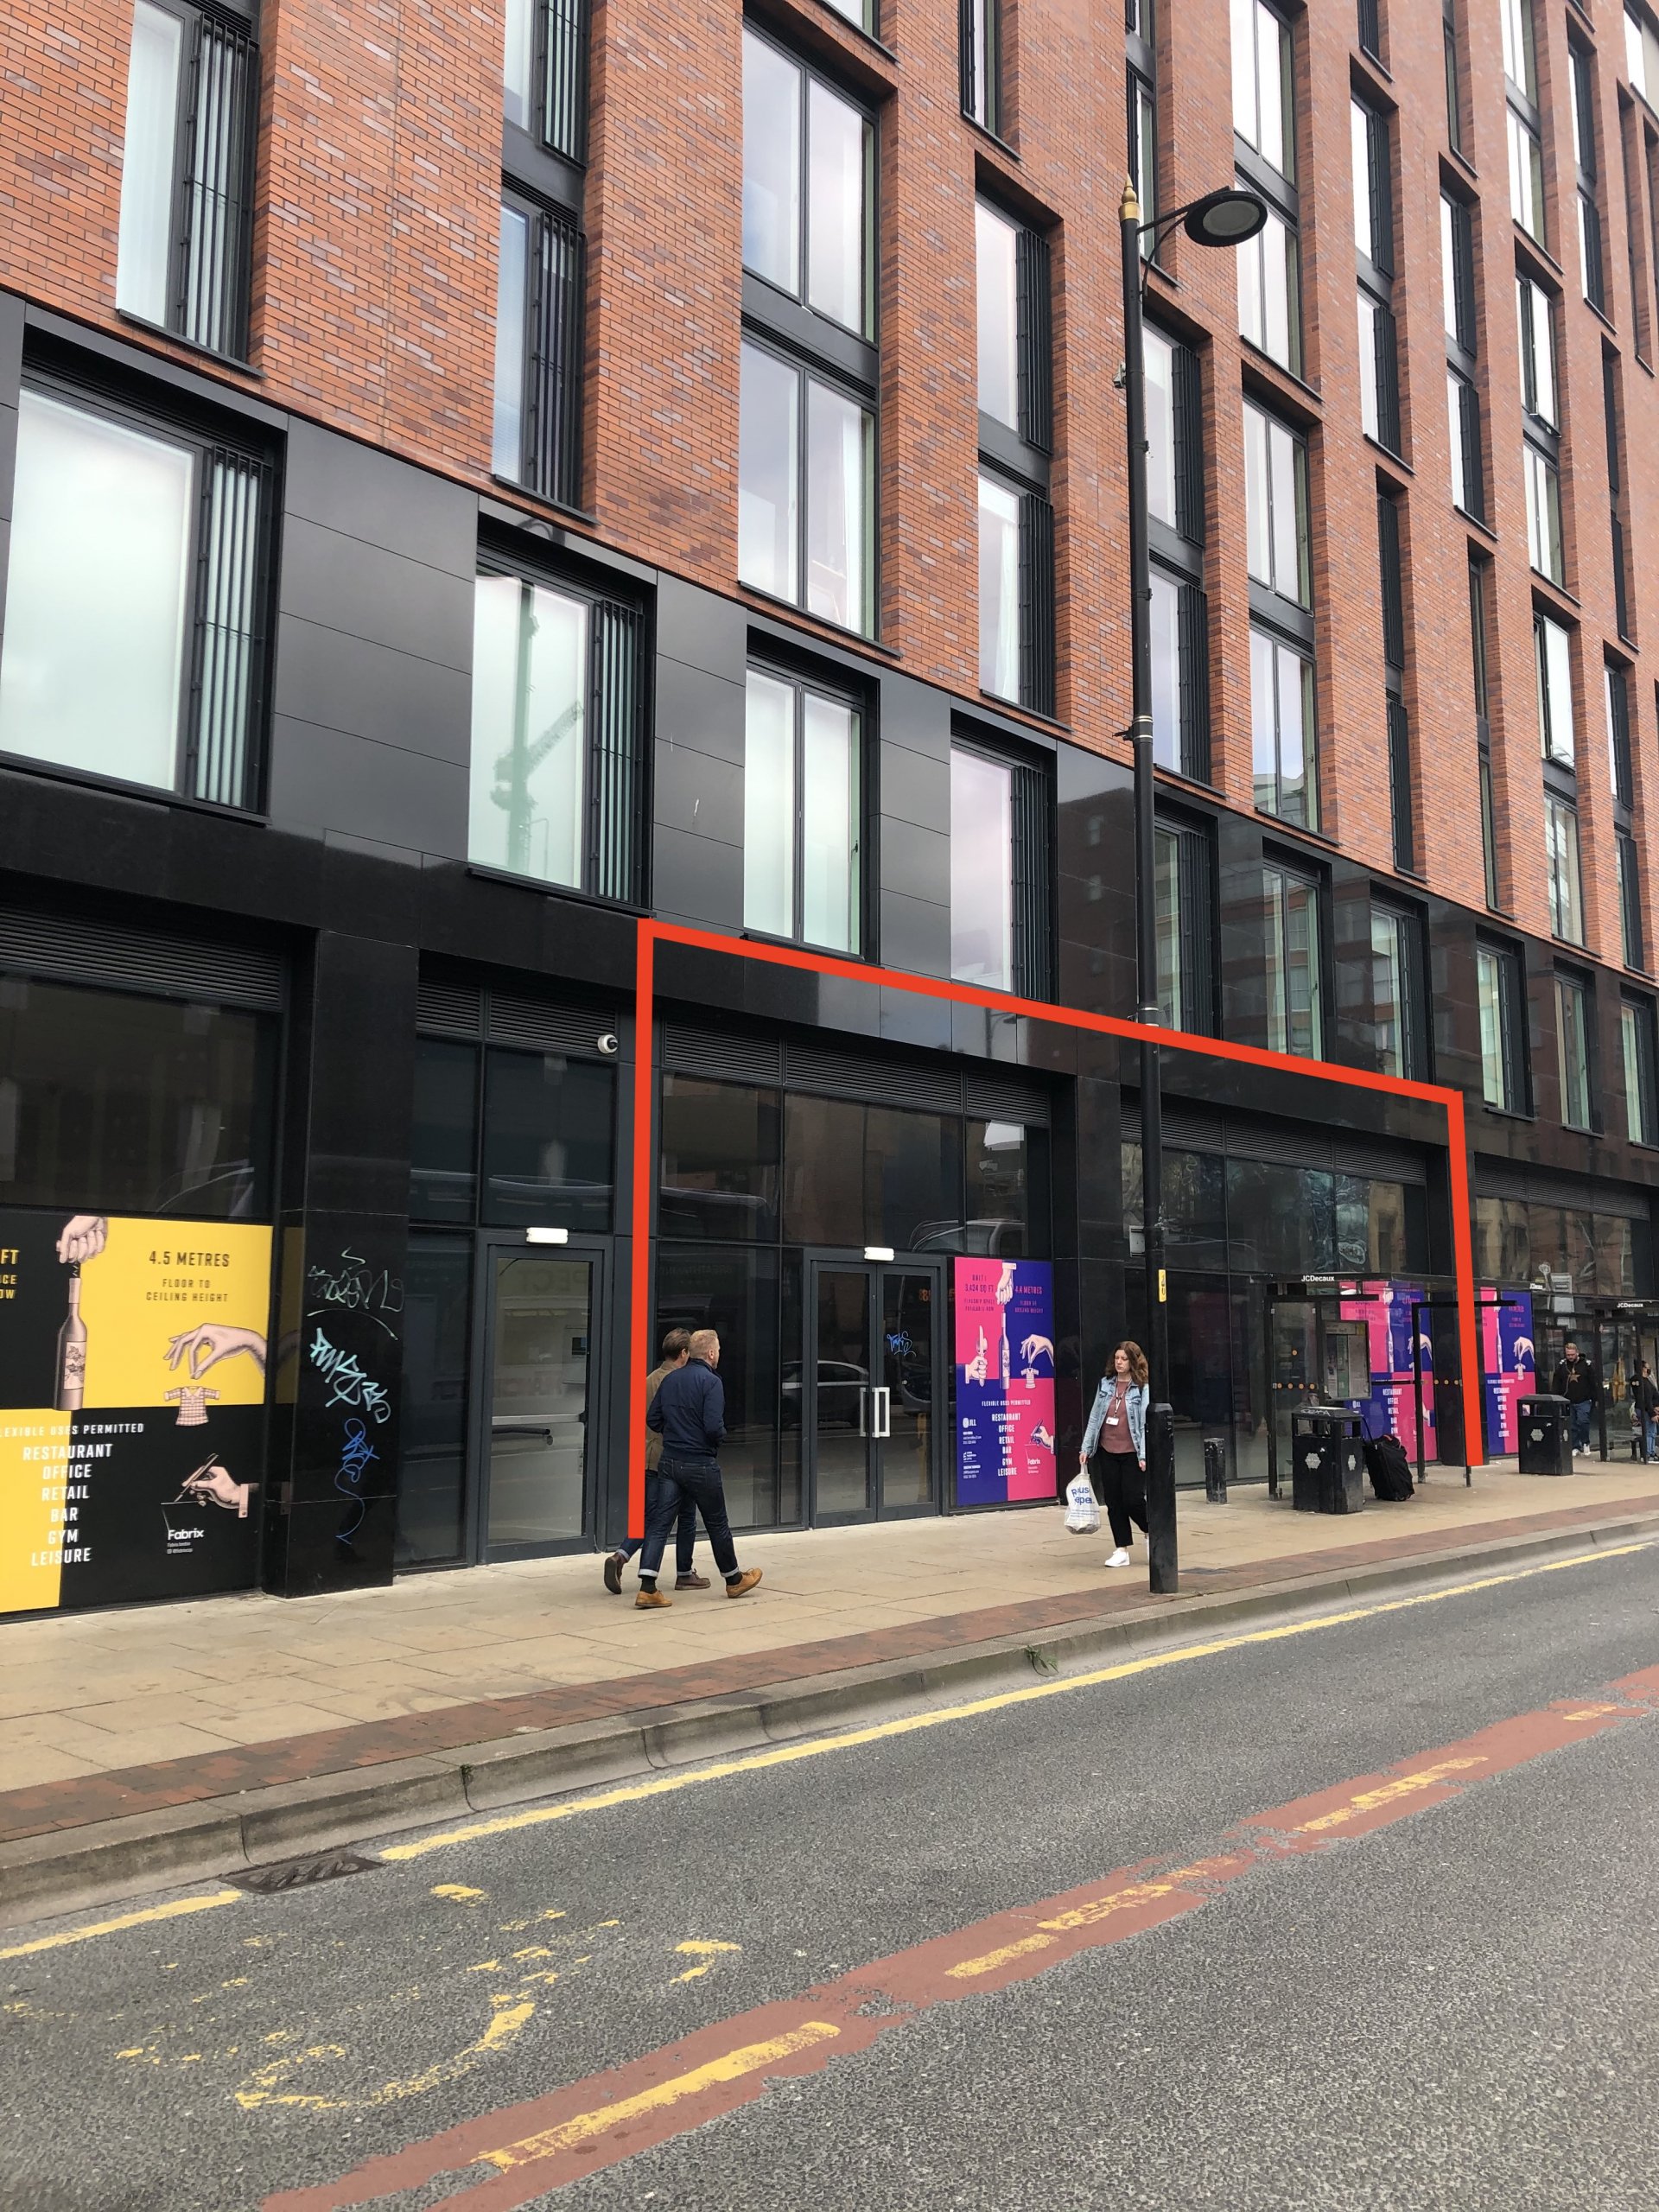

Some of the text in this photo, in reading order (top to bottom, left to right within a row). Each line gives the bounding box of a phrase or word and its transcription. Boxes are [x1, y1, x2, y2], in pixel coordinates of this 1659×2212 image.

[1, 1249, 20, 1264] FT
[149, 1250, 230, 1267] 4.5 METRES
[162, 1279, 211, 1288] FLOOR TO
[146, 1291, 228, 1302] CEILING HEIGHT
[991, 1413, 1021, 1421] RESTAURANT
[50, 1425, 79, 1436] USES
[83, 1423, 145, 1434] PERMITTED
[998, 1424, 1015, 1433] OFFICE
[999, 1436, 1015, 1445] RETAIL
[22, 1443, 114, 1461] RESTAURANT
[1001, 1446, 1012, 1454] BAR
[1001, 1458, 1013, 1466] GYM
[42, 1464, 92, 1480] OFFICE
[997, 1467, 1018, 1477] LEISURE
[41, 1484, 90, 1502] RETAIL
[50, 1506, 79, 1522] BAR
[48, 1528, 80, 1545] GYM
[167, 1527, 206, 1541] Fabrix
[31, 1547, 93, 1567] LEISURE
